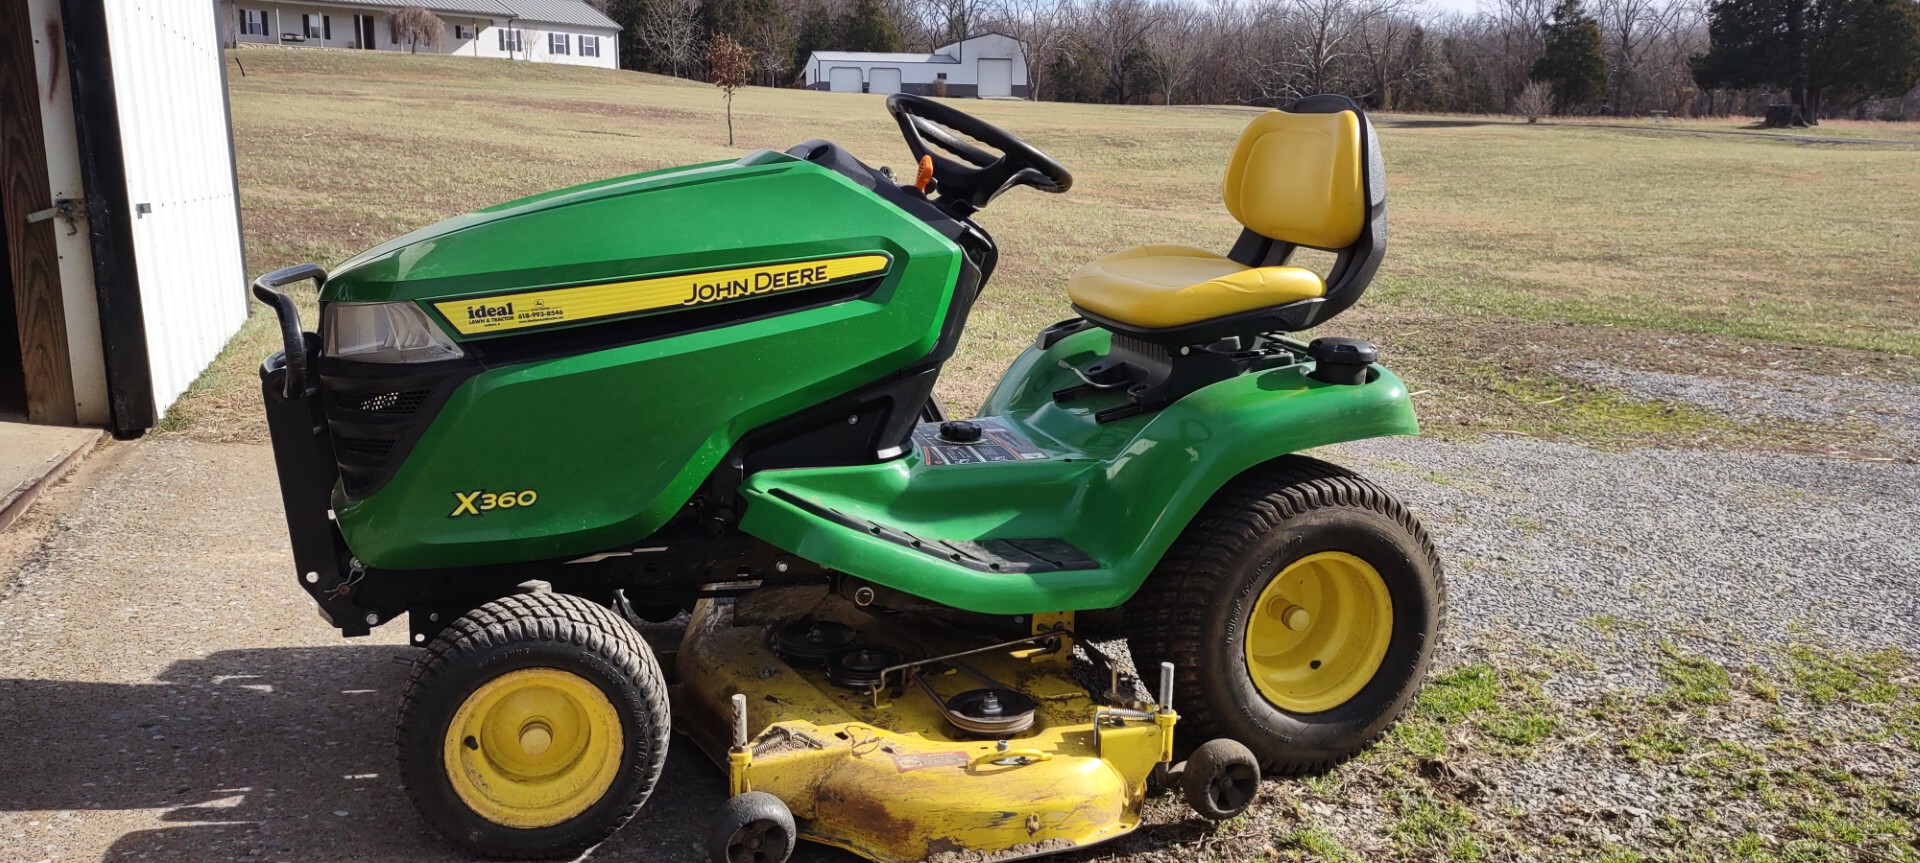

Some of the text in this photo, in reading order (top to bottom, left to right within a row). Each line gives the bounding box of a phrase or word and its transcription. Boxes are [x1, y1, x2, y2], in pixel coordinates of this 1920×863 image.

[684, 265, 828, 304] JOHN DEERE
[467, 302, 514, 319] ideal
[518, 309, 564, 320] 618-993-8546
[448, 490, 538, 518] X360
